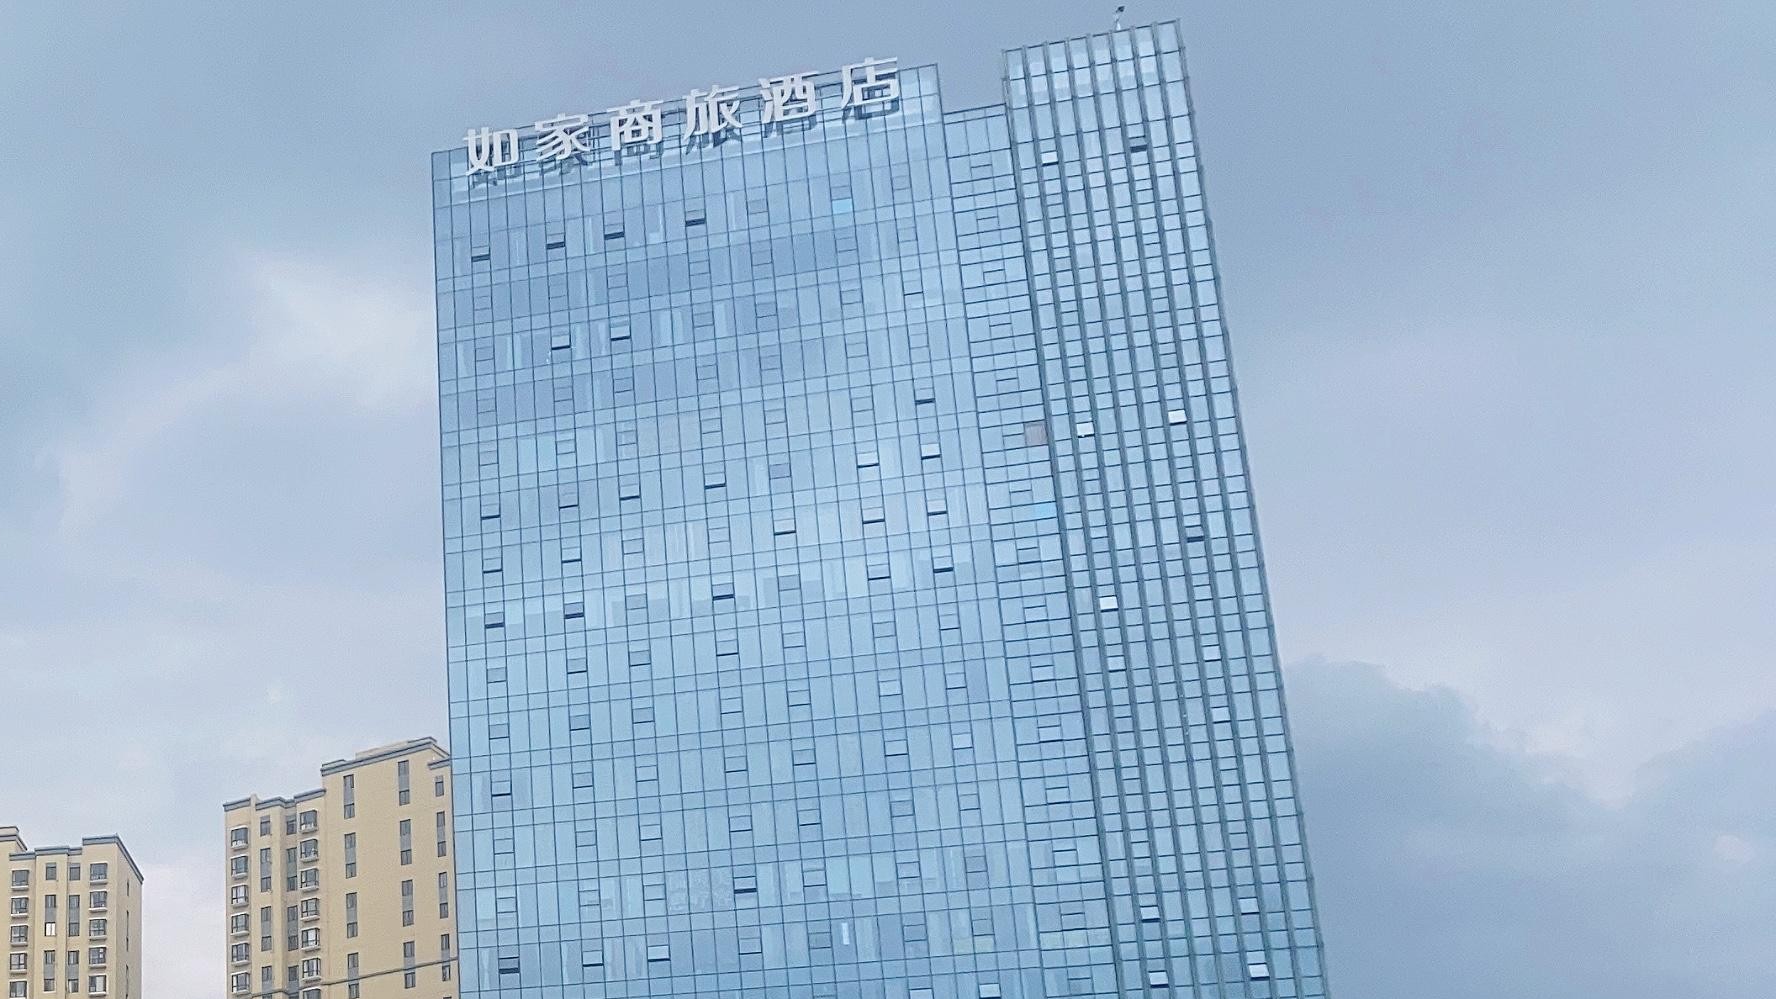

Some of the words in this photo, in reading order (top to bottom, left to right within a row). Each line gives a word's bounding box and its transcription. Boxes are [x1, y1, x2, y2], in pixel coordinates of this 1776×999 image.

[462, 56, 899, 176] 如家商旅酒店
